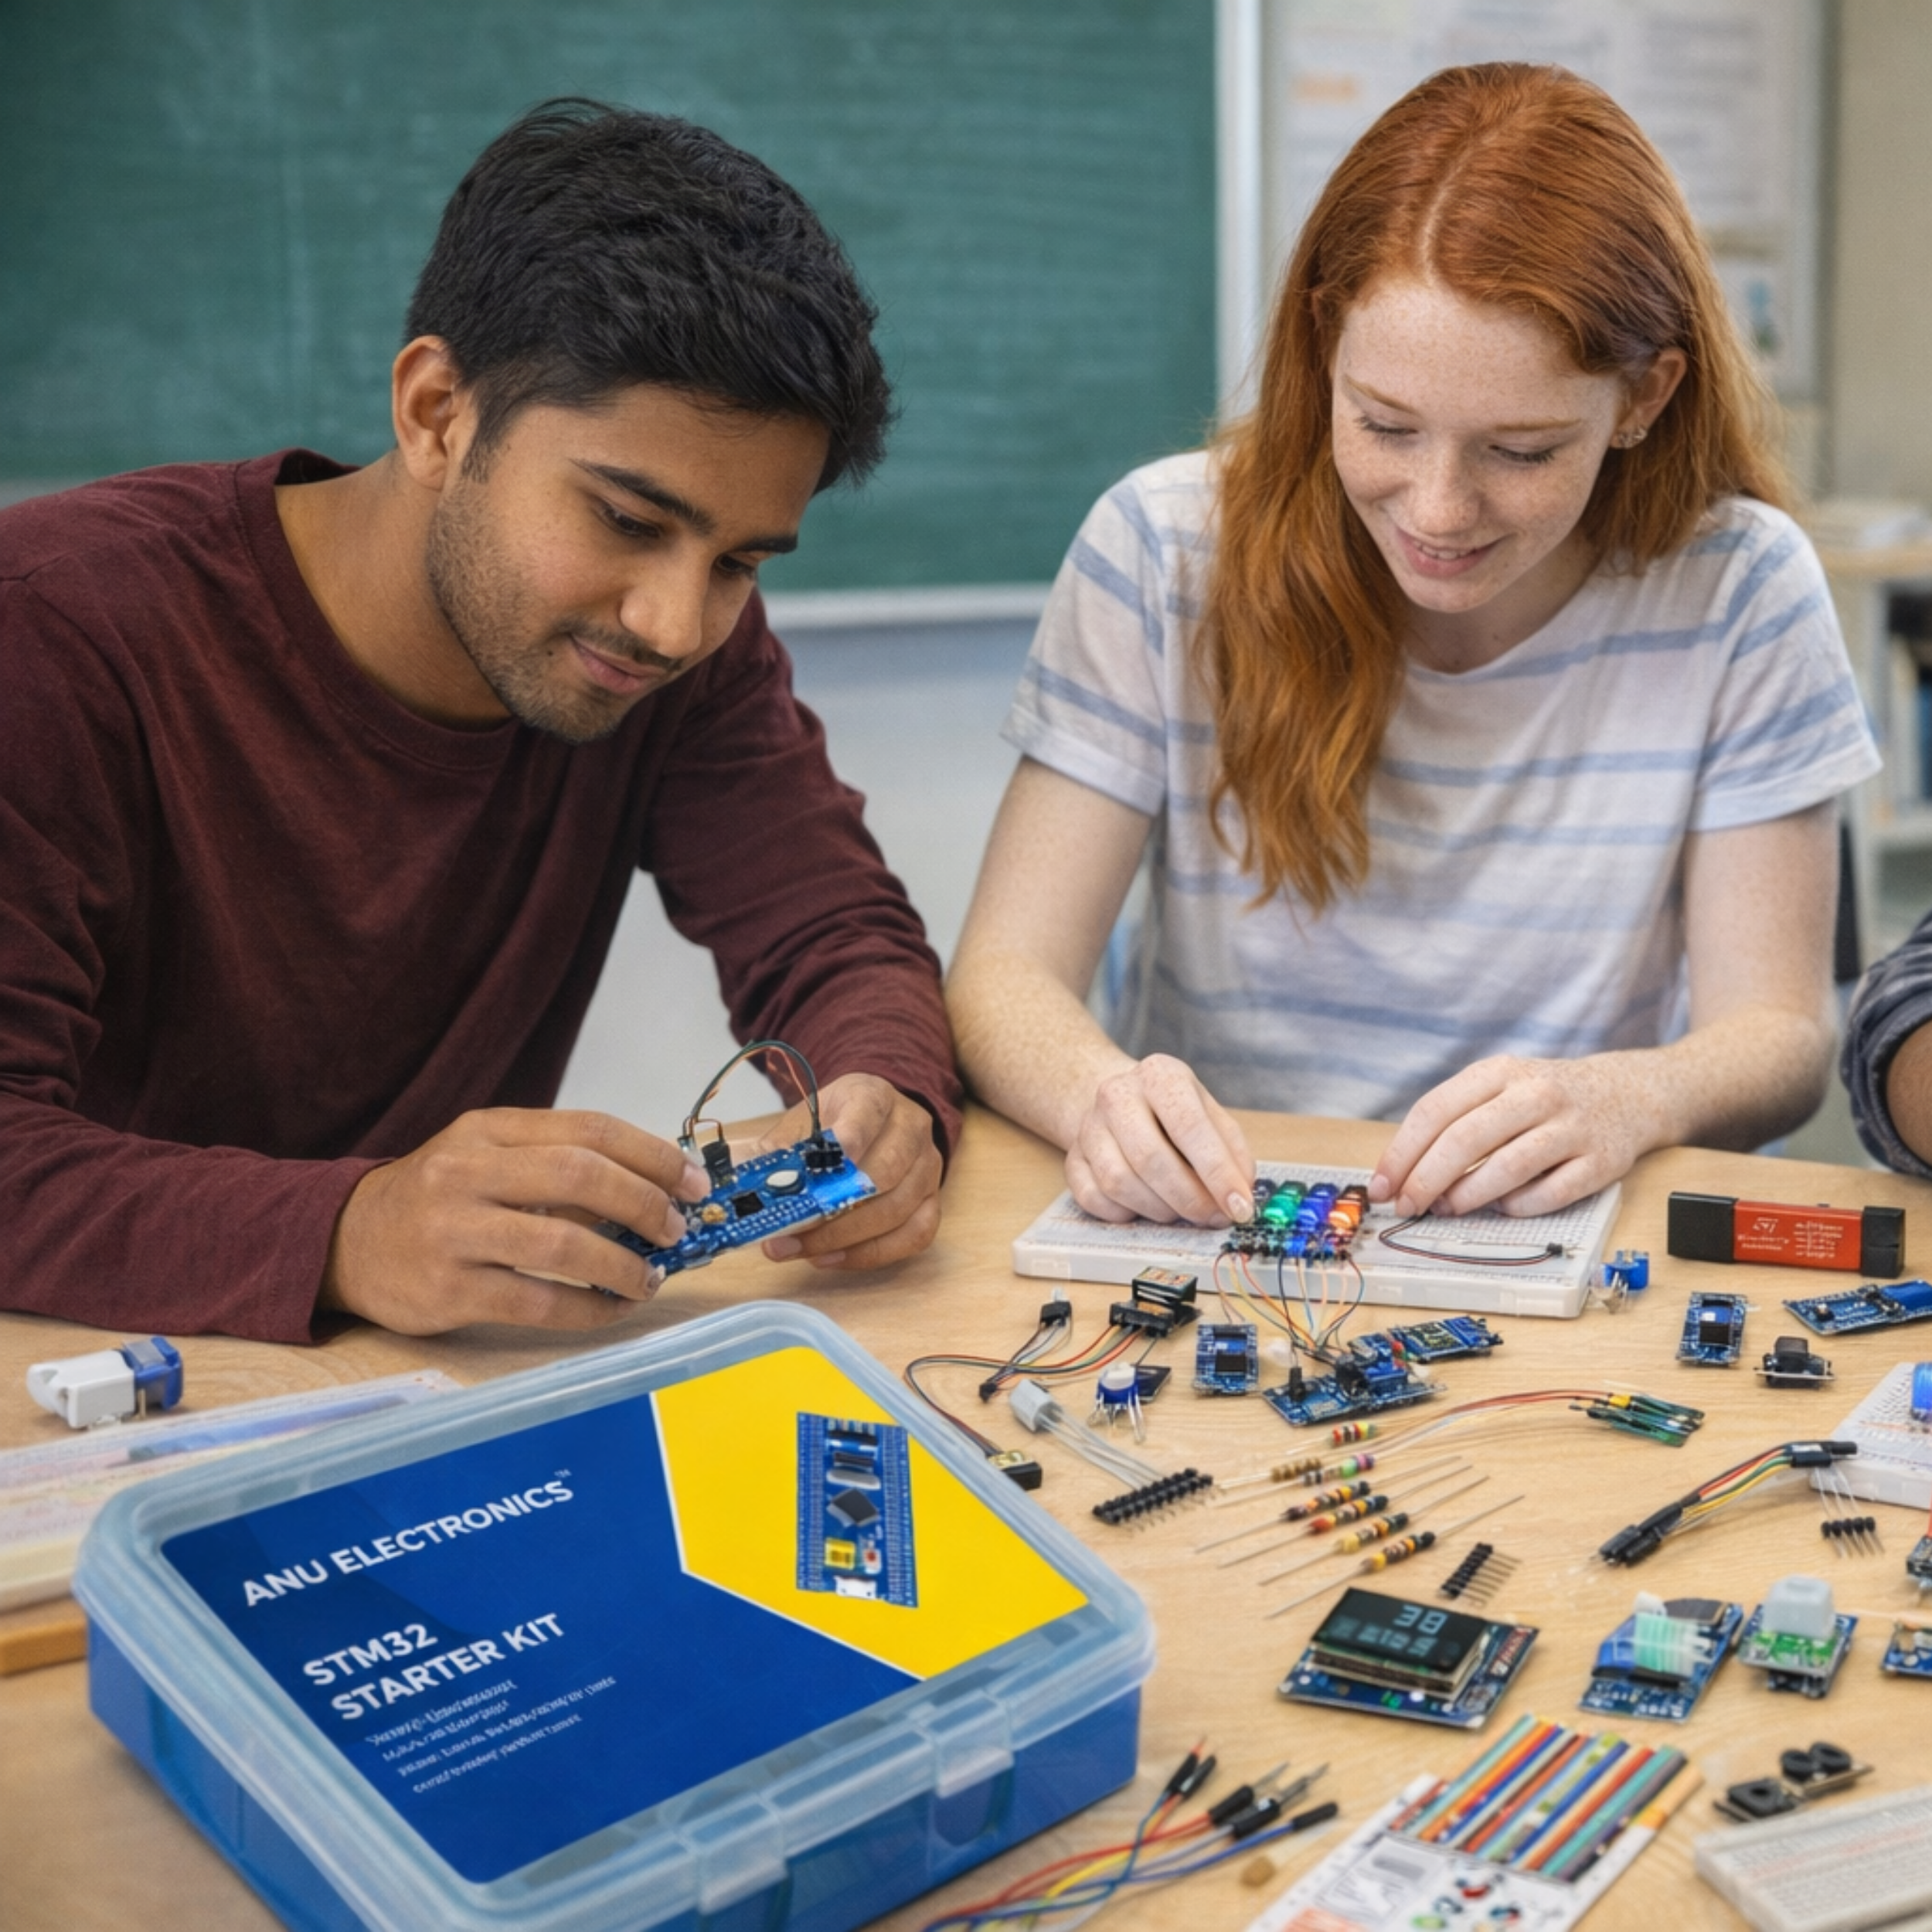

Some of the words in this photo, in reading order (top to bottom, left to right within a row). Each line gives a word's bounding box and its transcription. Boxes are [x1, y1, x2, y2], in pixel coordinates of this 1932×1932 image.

[243, 1560, 328, 1606] ANU
[331, 1481, 573, 1573] ELECTRONICS
[304, 1624, 437, 1685] STM32
[332, 1640, 505, 1719] STARTER
[502, 1614, 563, 1651] KIT
